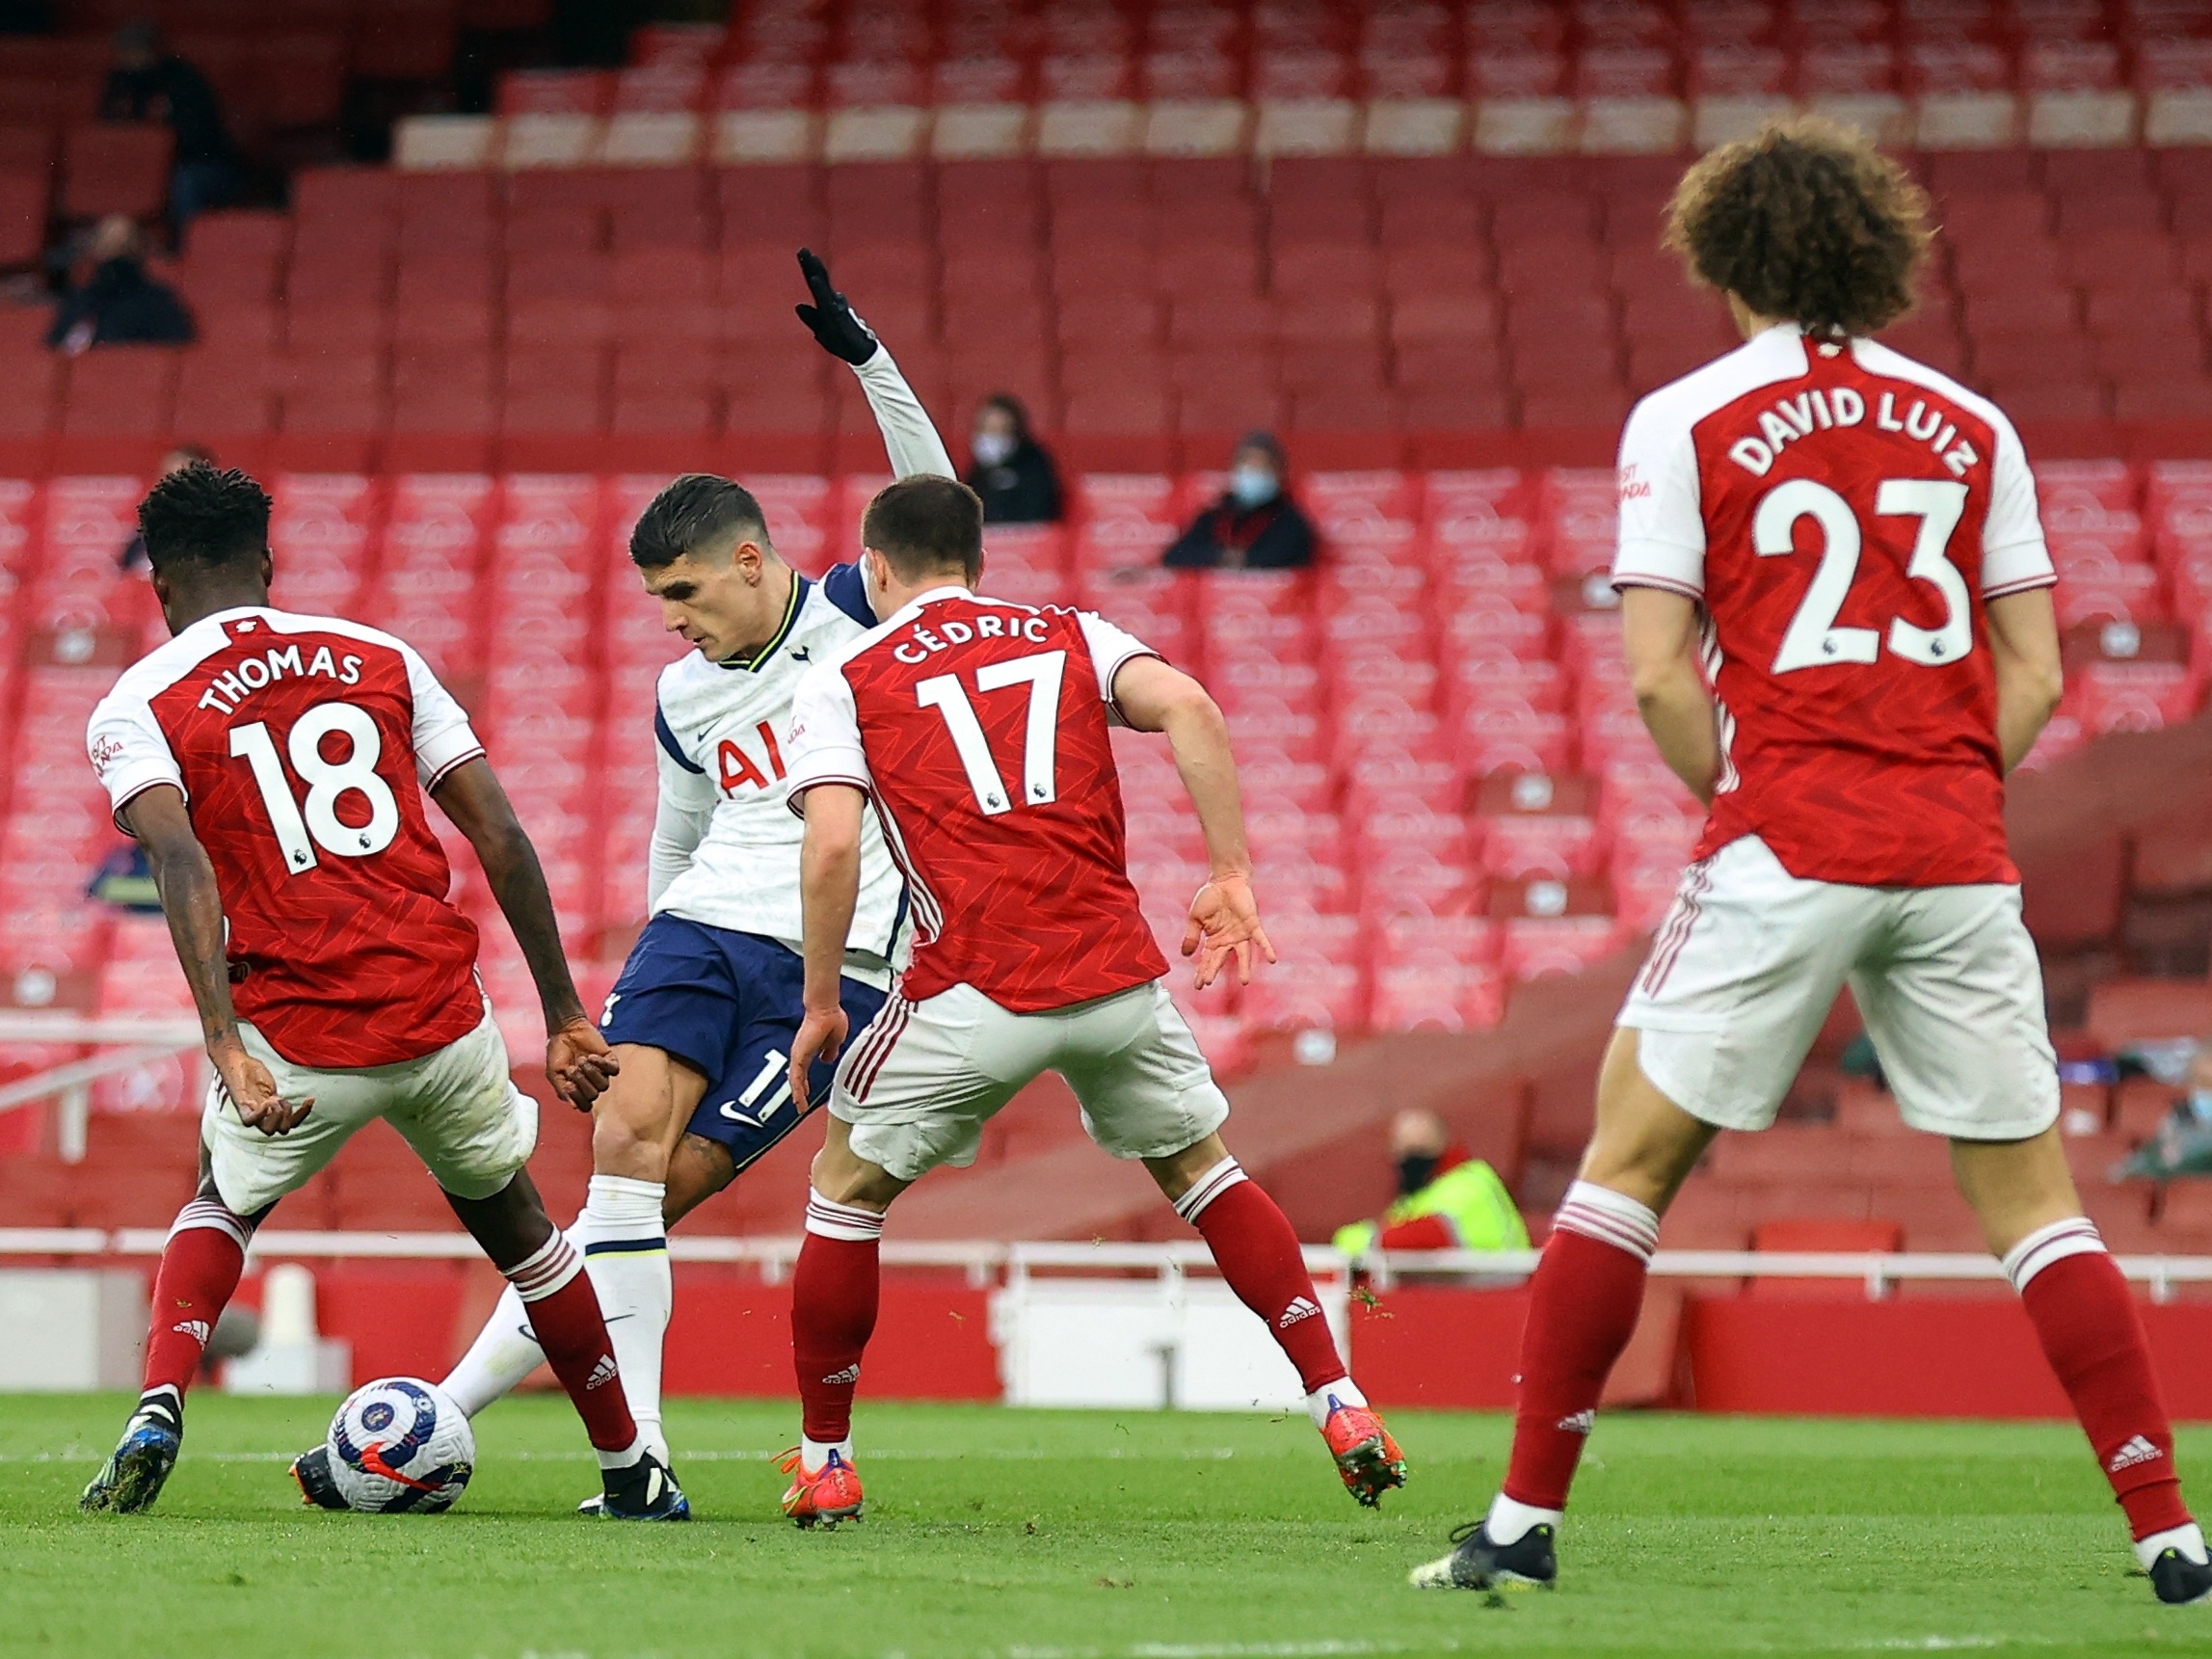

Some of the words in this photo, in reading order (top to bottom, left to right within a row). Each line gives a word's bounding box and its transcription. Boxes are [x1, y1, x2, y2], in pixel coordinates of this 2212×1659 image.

[1729, 387, 1865, 476] DAVID
[1877, 391, 1979, 476] LUIZ
[1752, 478, 1974, 675] 23
[198, 644, 363, 716] THOMAS
[893, 615, 1050, 665] CÉDRIC
[915, 650, 1067, 816] 17
[228, 702, 400, 875] 18
[1279, 1305, 1321, 1328] adidas
[2110, 1448, 2164, 1472] adidas
